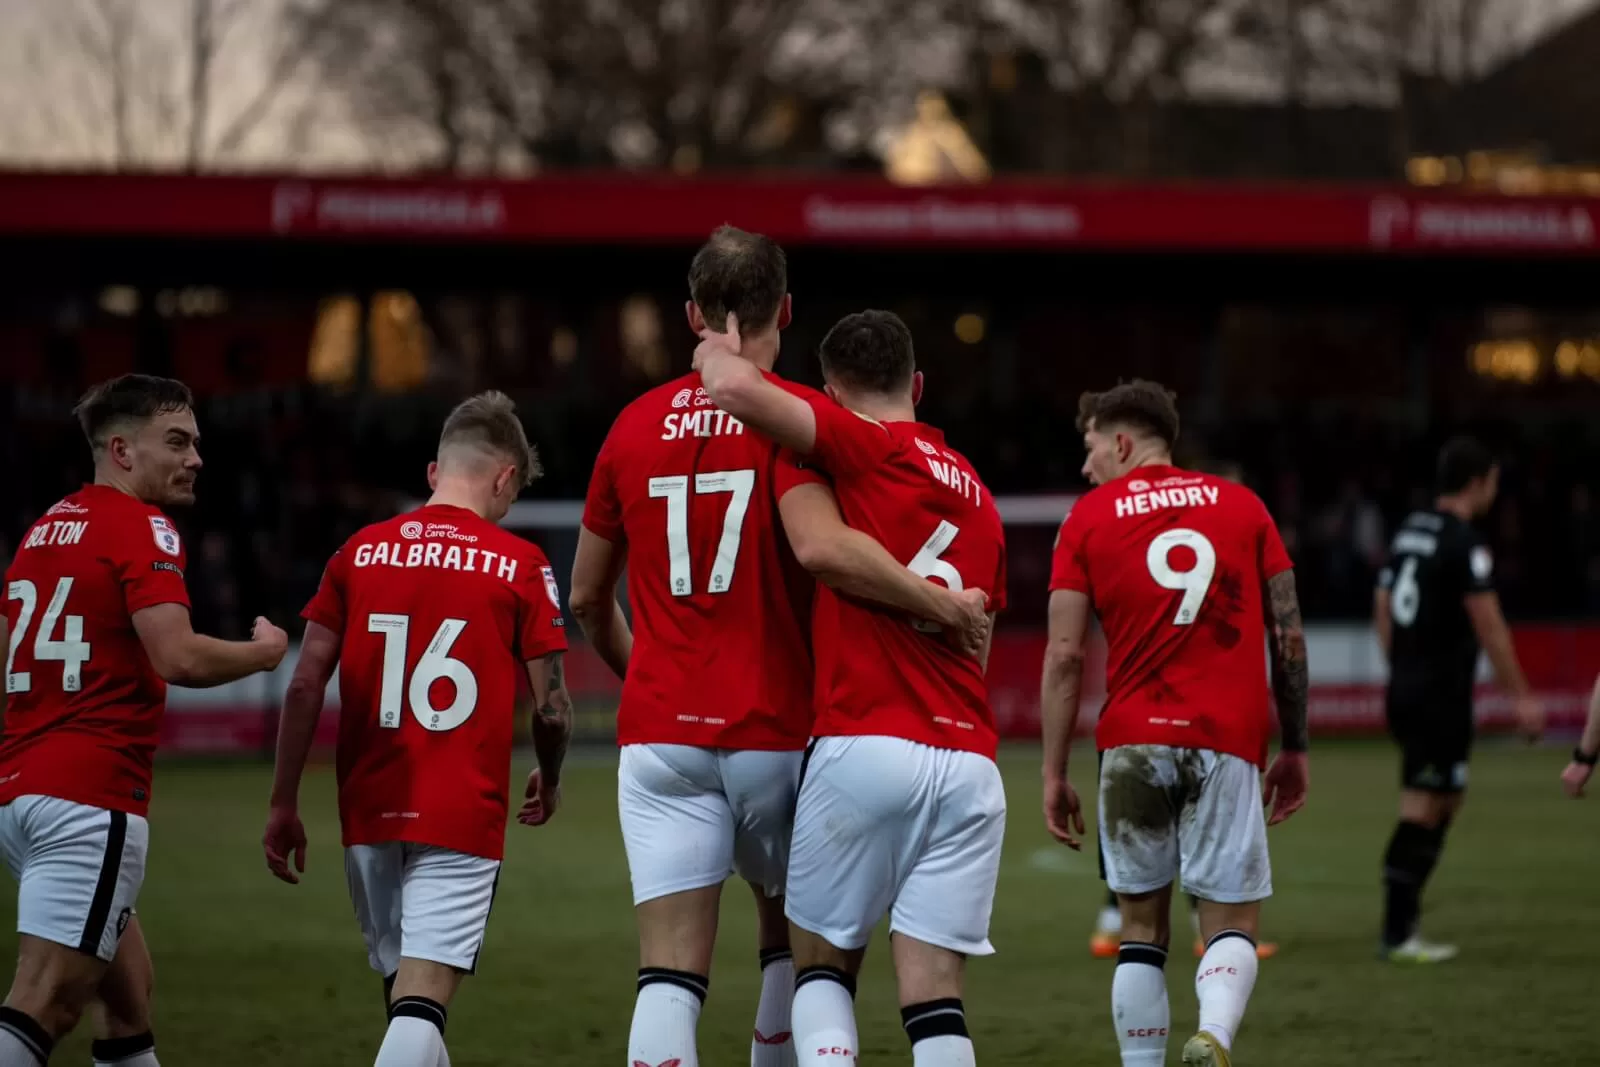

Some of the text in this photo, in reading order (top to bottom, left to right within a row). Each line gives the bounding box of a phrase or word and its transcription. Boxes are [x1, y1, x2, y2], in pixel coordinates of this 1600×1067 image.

[661, 409, 744, 441] SMITH
[925, 456, 981, 507] WATT
[1115, 484, 1219, 518] HENDRY
[24, 521, 89, 550] BOLTON
[424, 529, 478, 543] Care Group
[426, 522, 459, 532] Quality
[648, 469, 755, 596] 17
[353, 542, 518, 582] GALBRAITH
[1146, 528, 1217, 625] 9
[6, 576, 91, 693] 24
[368, 613, 478, 731] 16
[1198, 966, 1238, 982] SCFC
[1127, 1027, 1168, 1038] SCFC
[817, 1046, 855, 1060] SCF
